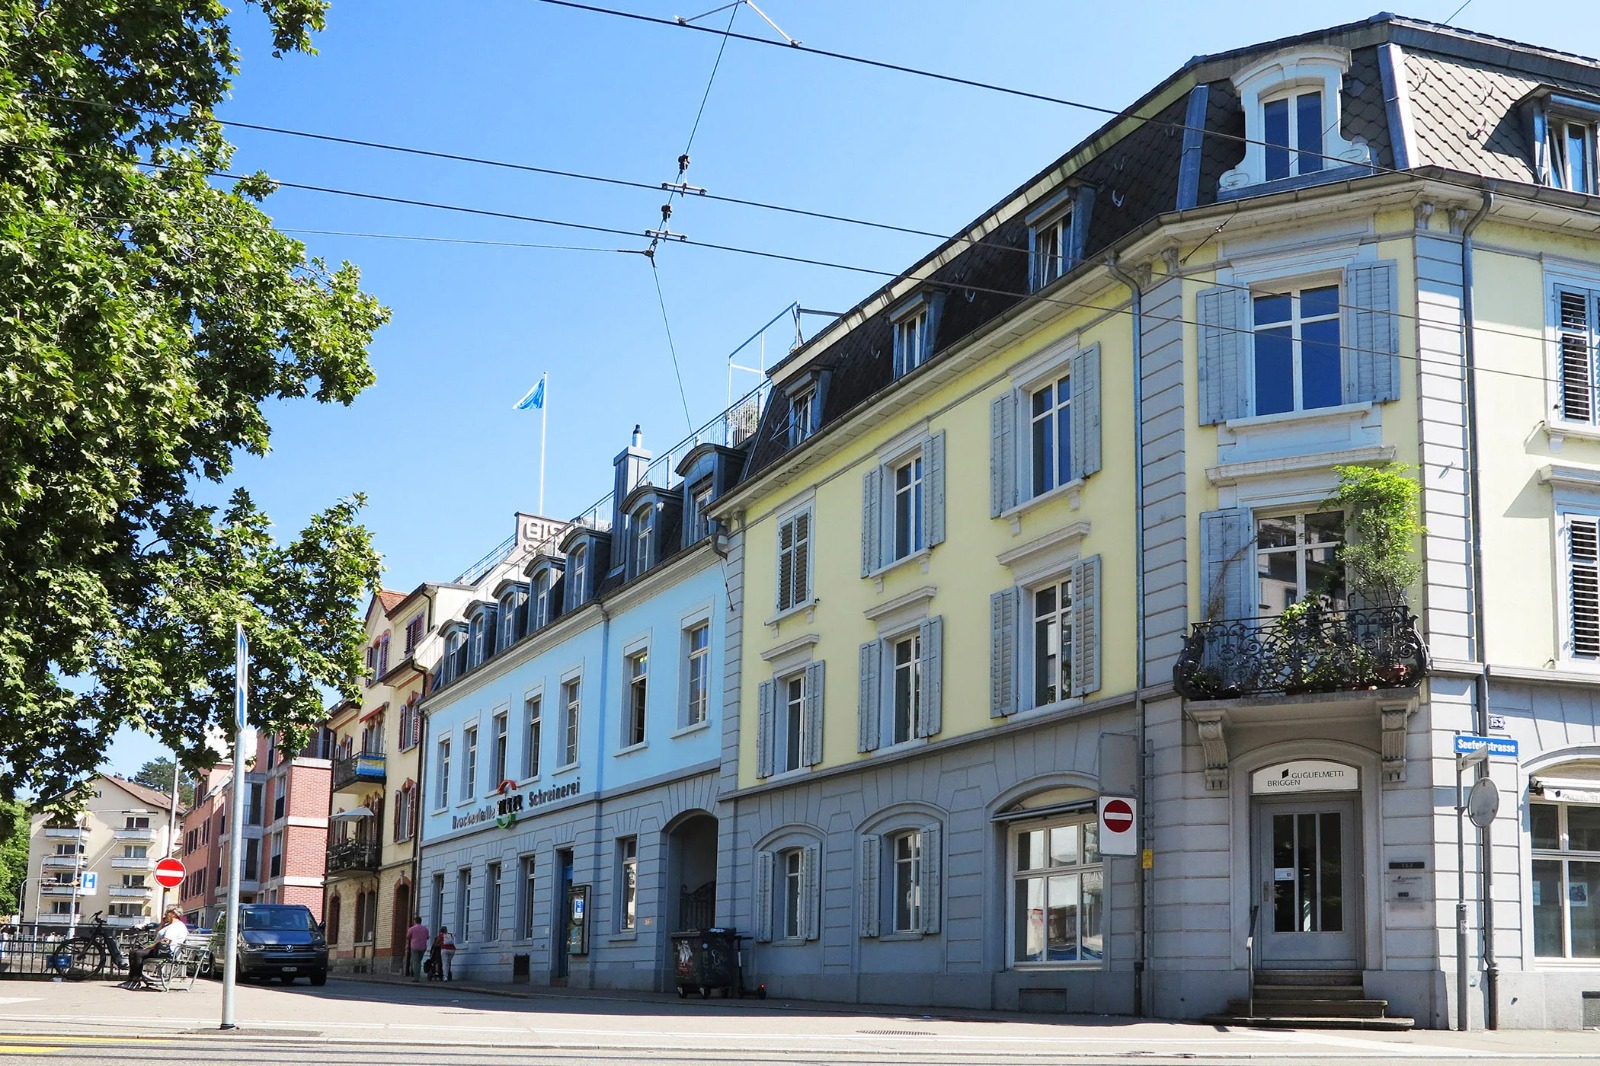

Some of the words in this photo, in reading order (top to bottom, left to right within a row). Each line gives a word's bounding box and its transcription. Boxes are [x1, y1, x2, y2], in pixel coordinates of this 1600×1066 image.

[1490, 717, 1504, 728] 153
[1291, 770, 1345, 779] GUGLIELMETTI
[1267, 779, 1301, 787] BRIGGEN
[529, 776, 580, 807] Schreinerei
